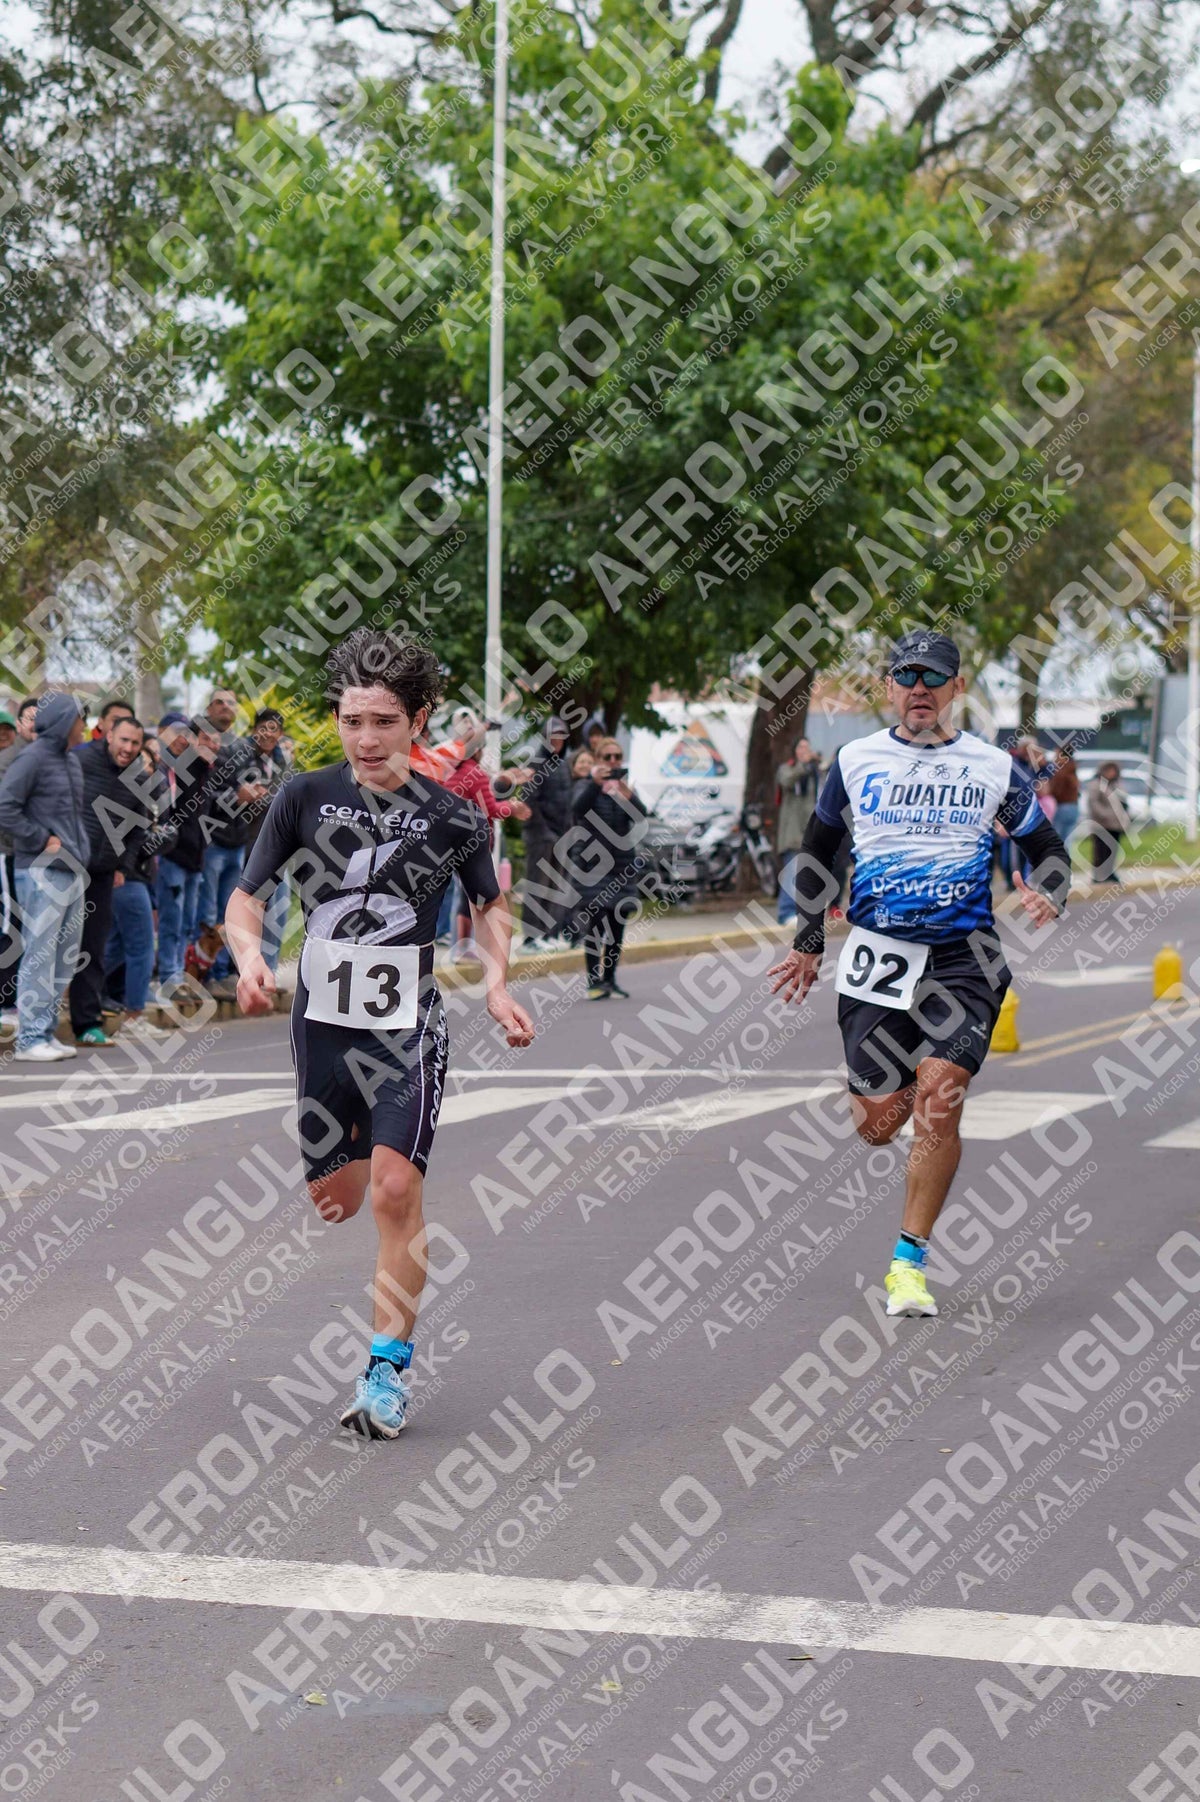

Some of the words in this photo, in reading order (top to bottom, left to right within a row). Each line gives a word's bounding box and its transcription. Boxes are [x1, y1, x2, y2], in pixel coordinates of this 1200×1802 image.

[888, 782, 986, 809] DUATLÓN
[318, 817, 428, 840] VROOMEN.WHTE.DESIGN
[319, 803, 429, 832] cervélo
[873, 809, 924, 826] CIUDAD
[926, 809, 945, 824] DE
[949, 809, 982, 826] GOYA
[905, 825, 941, 835] 2026
[845, 944, 909, 999] 92
[328, 960, 401, 1018] 13
